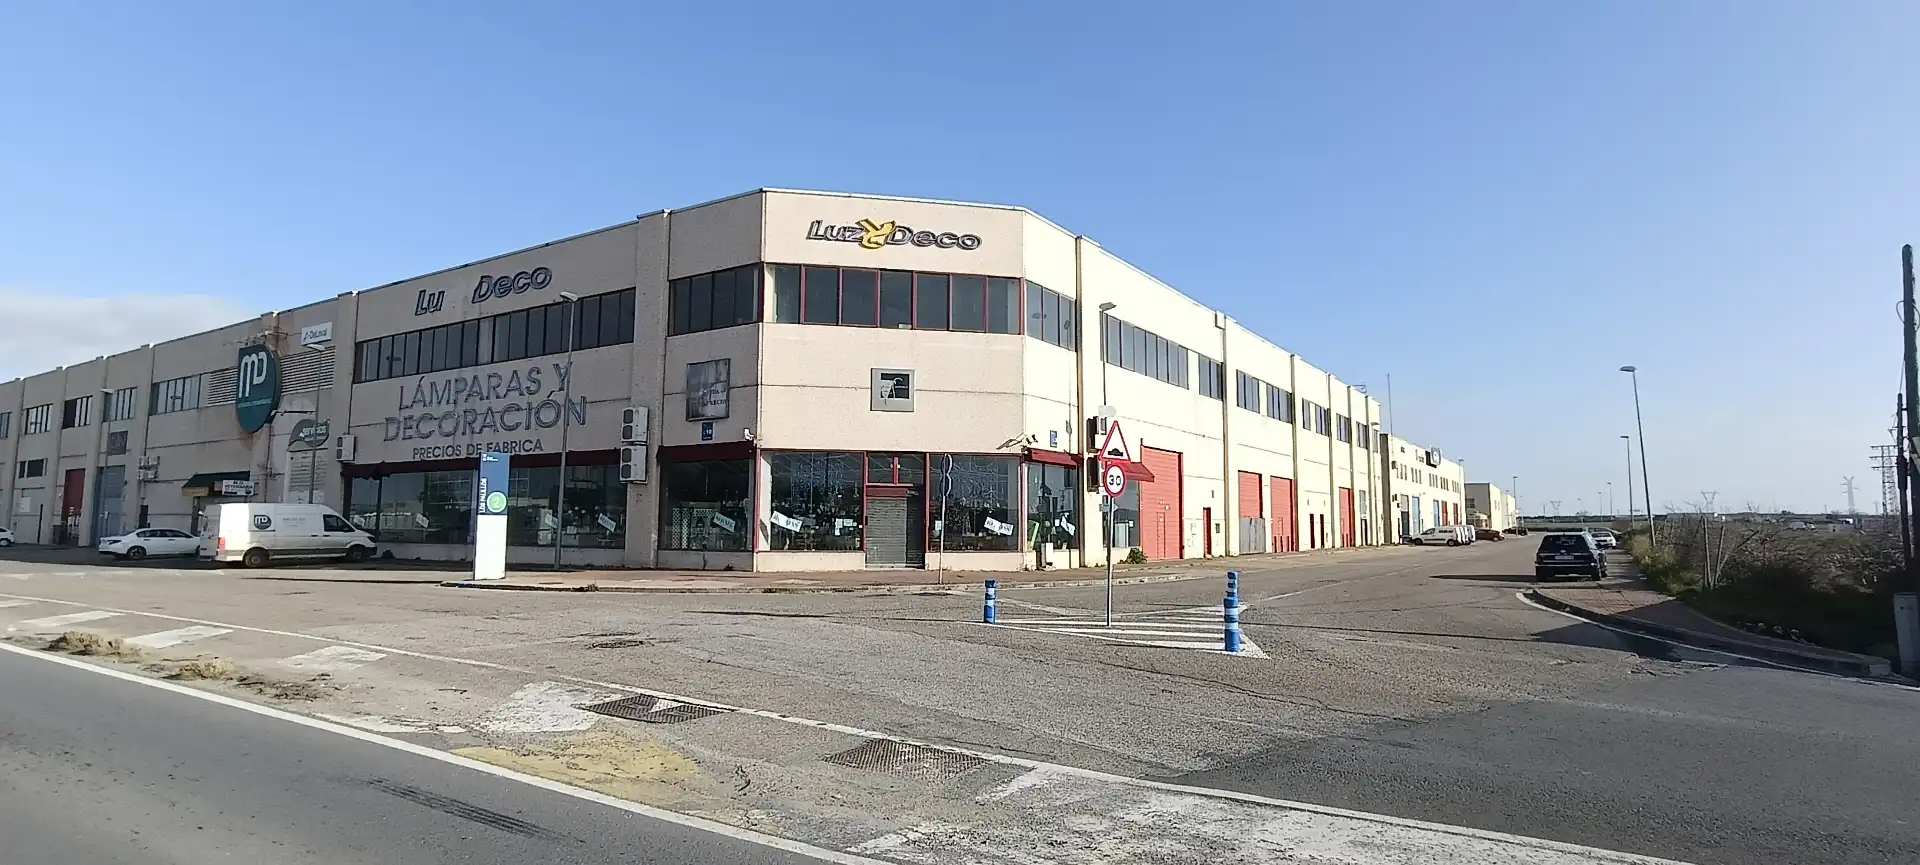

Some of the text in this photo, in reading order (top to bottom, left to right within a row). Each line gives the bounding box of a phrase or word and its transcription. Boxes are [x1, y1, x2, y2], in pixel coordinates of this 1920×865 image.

[806, 219, 863, 242] Luz
[887, 225, 982, 251] Deco
[415, 266, 552, 316] Lu Deco
[398, 361, 573, 411] LÁMPARAS Y
[383, 390, 587, 442] DECORACIÓN
[412, 444, 462, 460] PRECIOS
[486, 438, 544, 454] FABRICA
[1108, 474, 1122, 486] 30
[493, 496, 500, 508] 2
